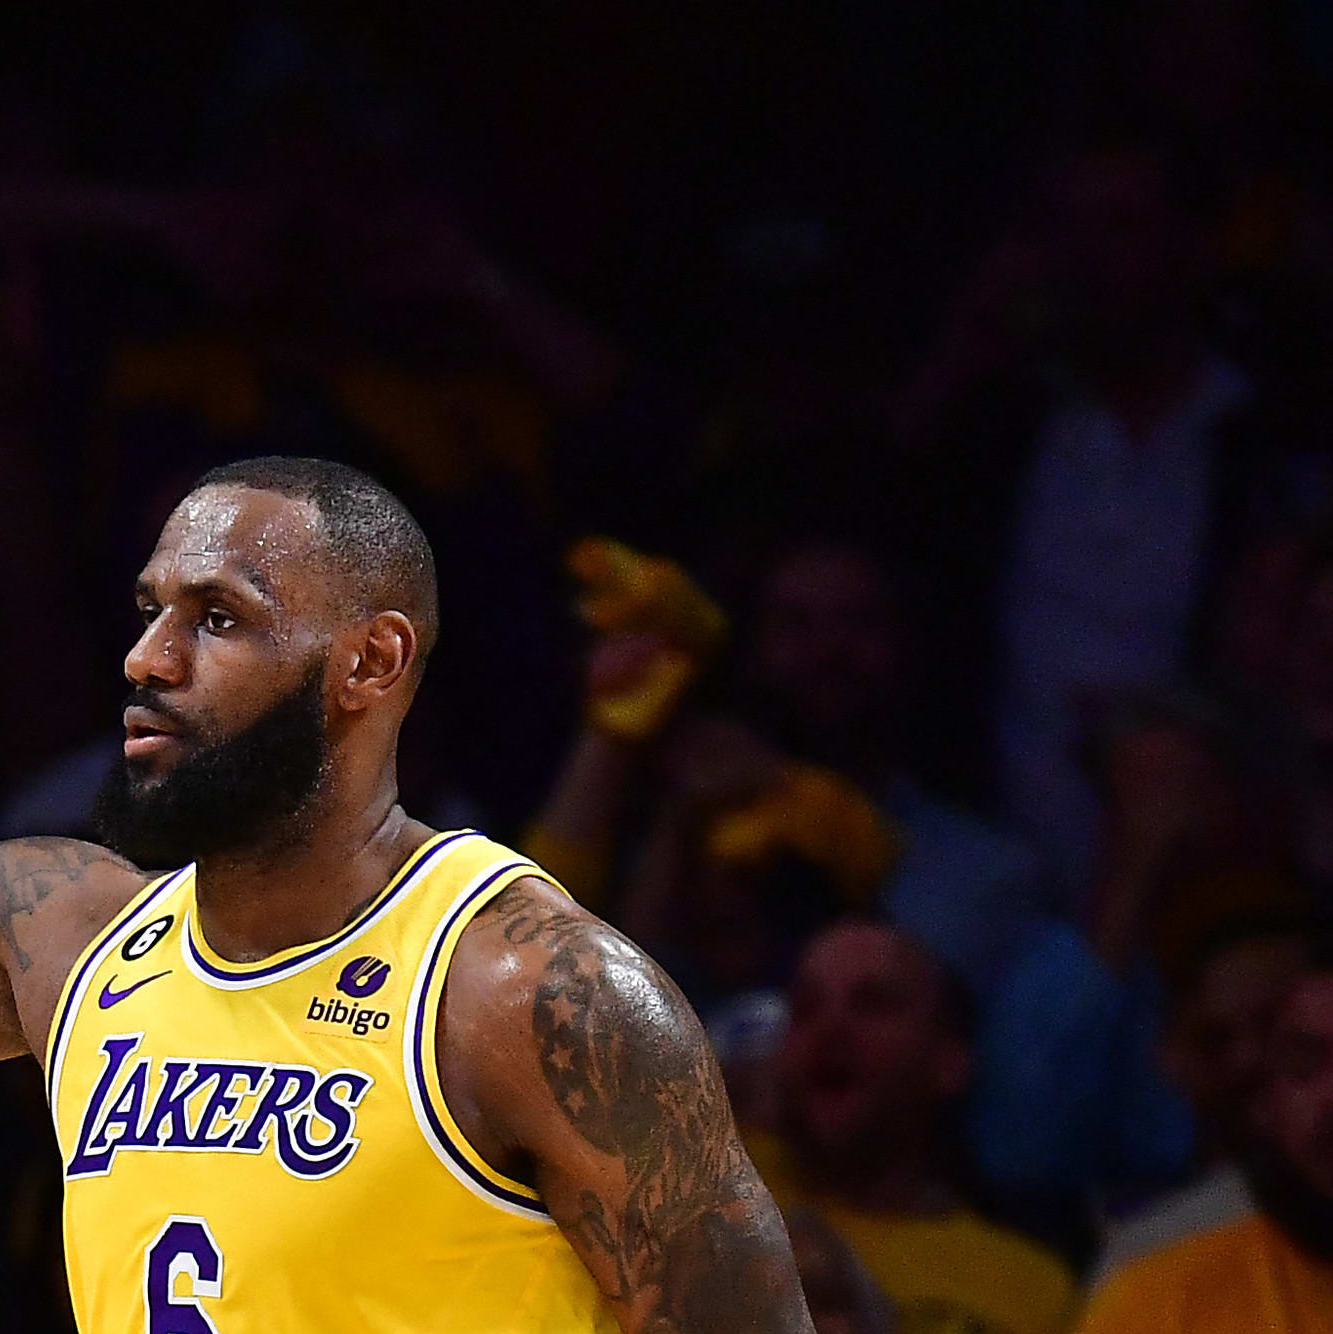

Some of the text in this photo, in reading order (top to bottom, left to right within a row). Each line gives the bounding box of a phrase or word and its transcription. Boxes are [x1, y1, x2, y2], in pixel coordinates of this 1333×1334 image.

[131, 919, 168, 956] 6
[306, 997, 391, 1035] bibigo
[65, 1031, 375, 1181] LAKERS
